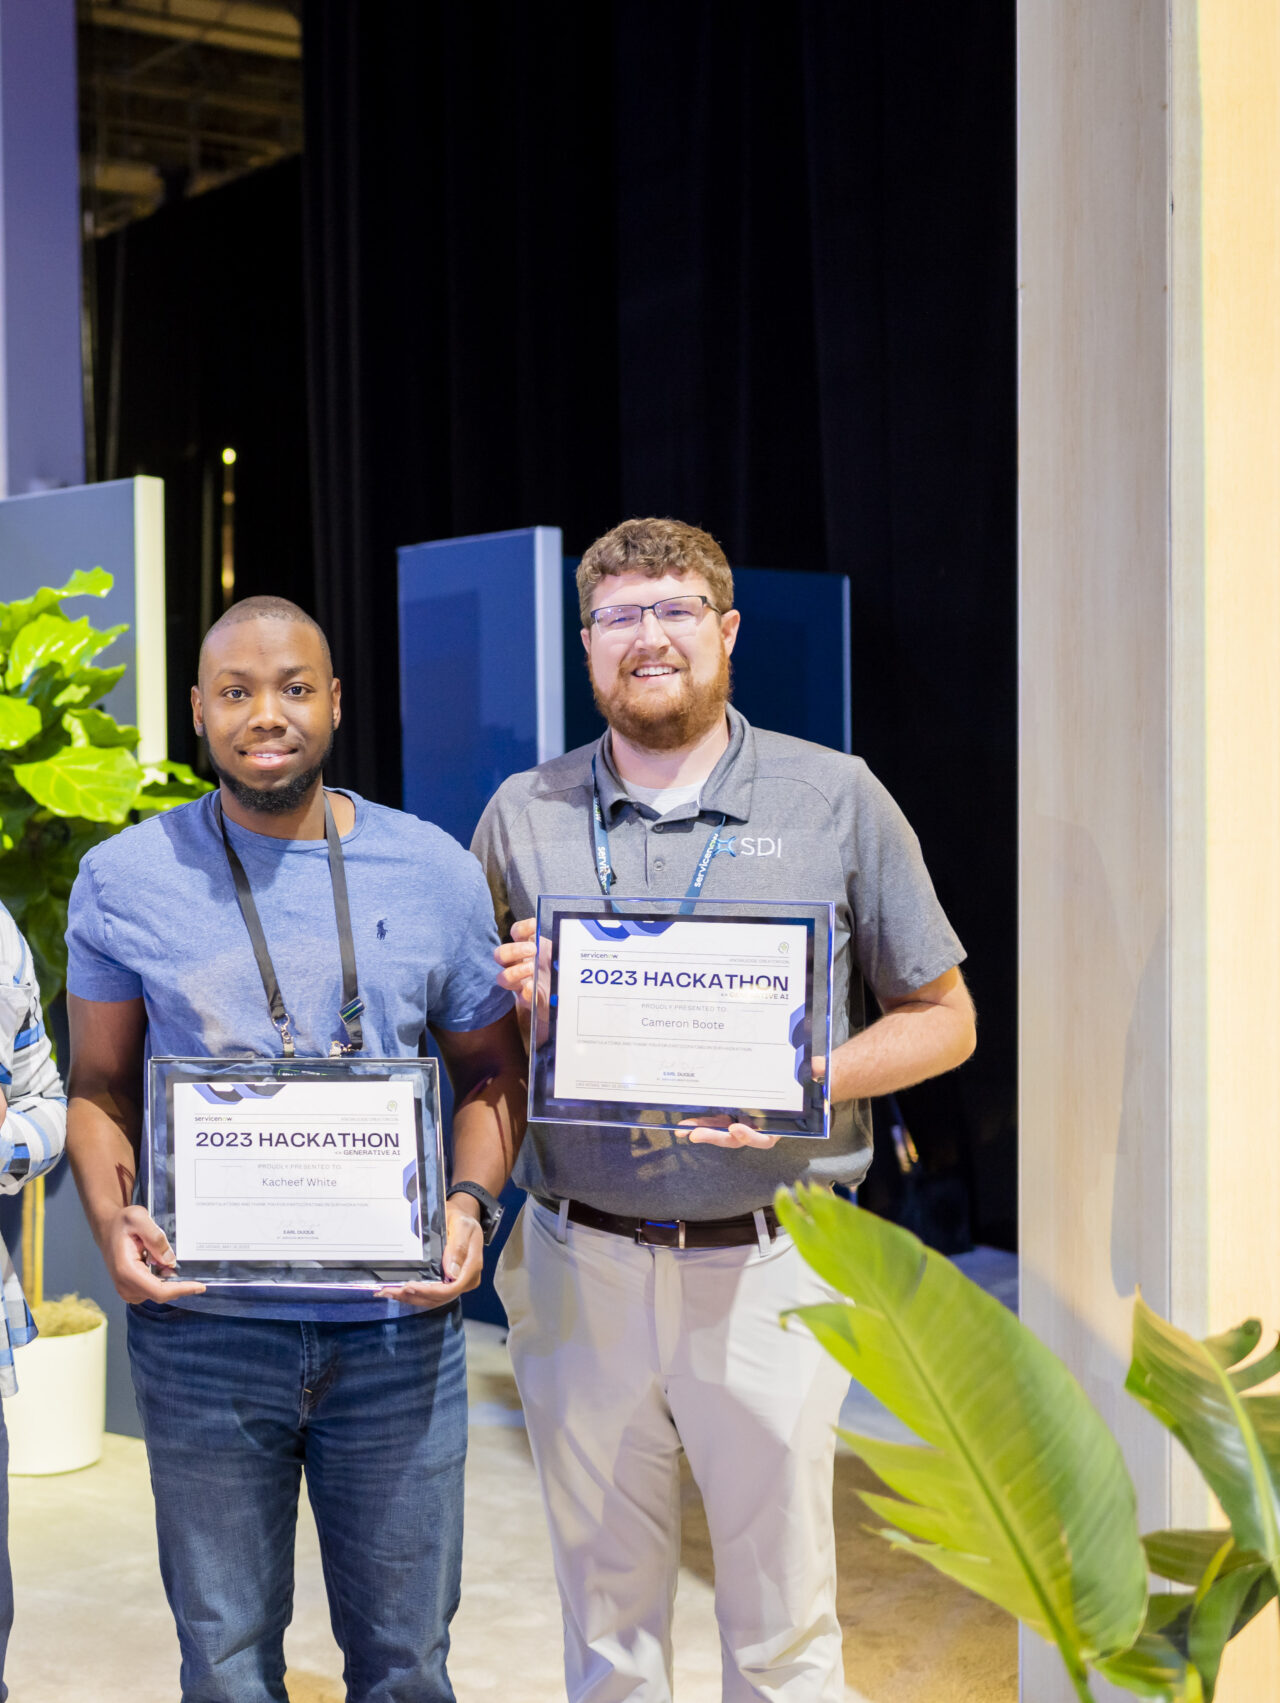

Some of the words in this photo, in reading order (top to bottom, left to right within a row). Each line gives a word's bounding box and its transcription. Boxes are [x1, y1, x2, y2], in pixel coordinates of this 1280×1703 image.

[740, 836, 782, 858] SDI
[580, 952, 619, 960] servicenow
[580, 968, 638, 986] 2023
[644, 971, 789, 992] HACKATHON
[641, 1017, 689, 1028] Cameron
[692, 1019, 725, 1030] Boote
[195, 1132, 253, 1148] 2023
[259, 1132, 400, 1148] HACKATHON
[262, 1177, 304, 1187] Kacheef
[306, 1177, 337, 1187] White
